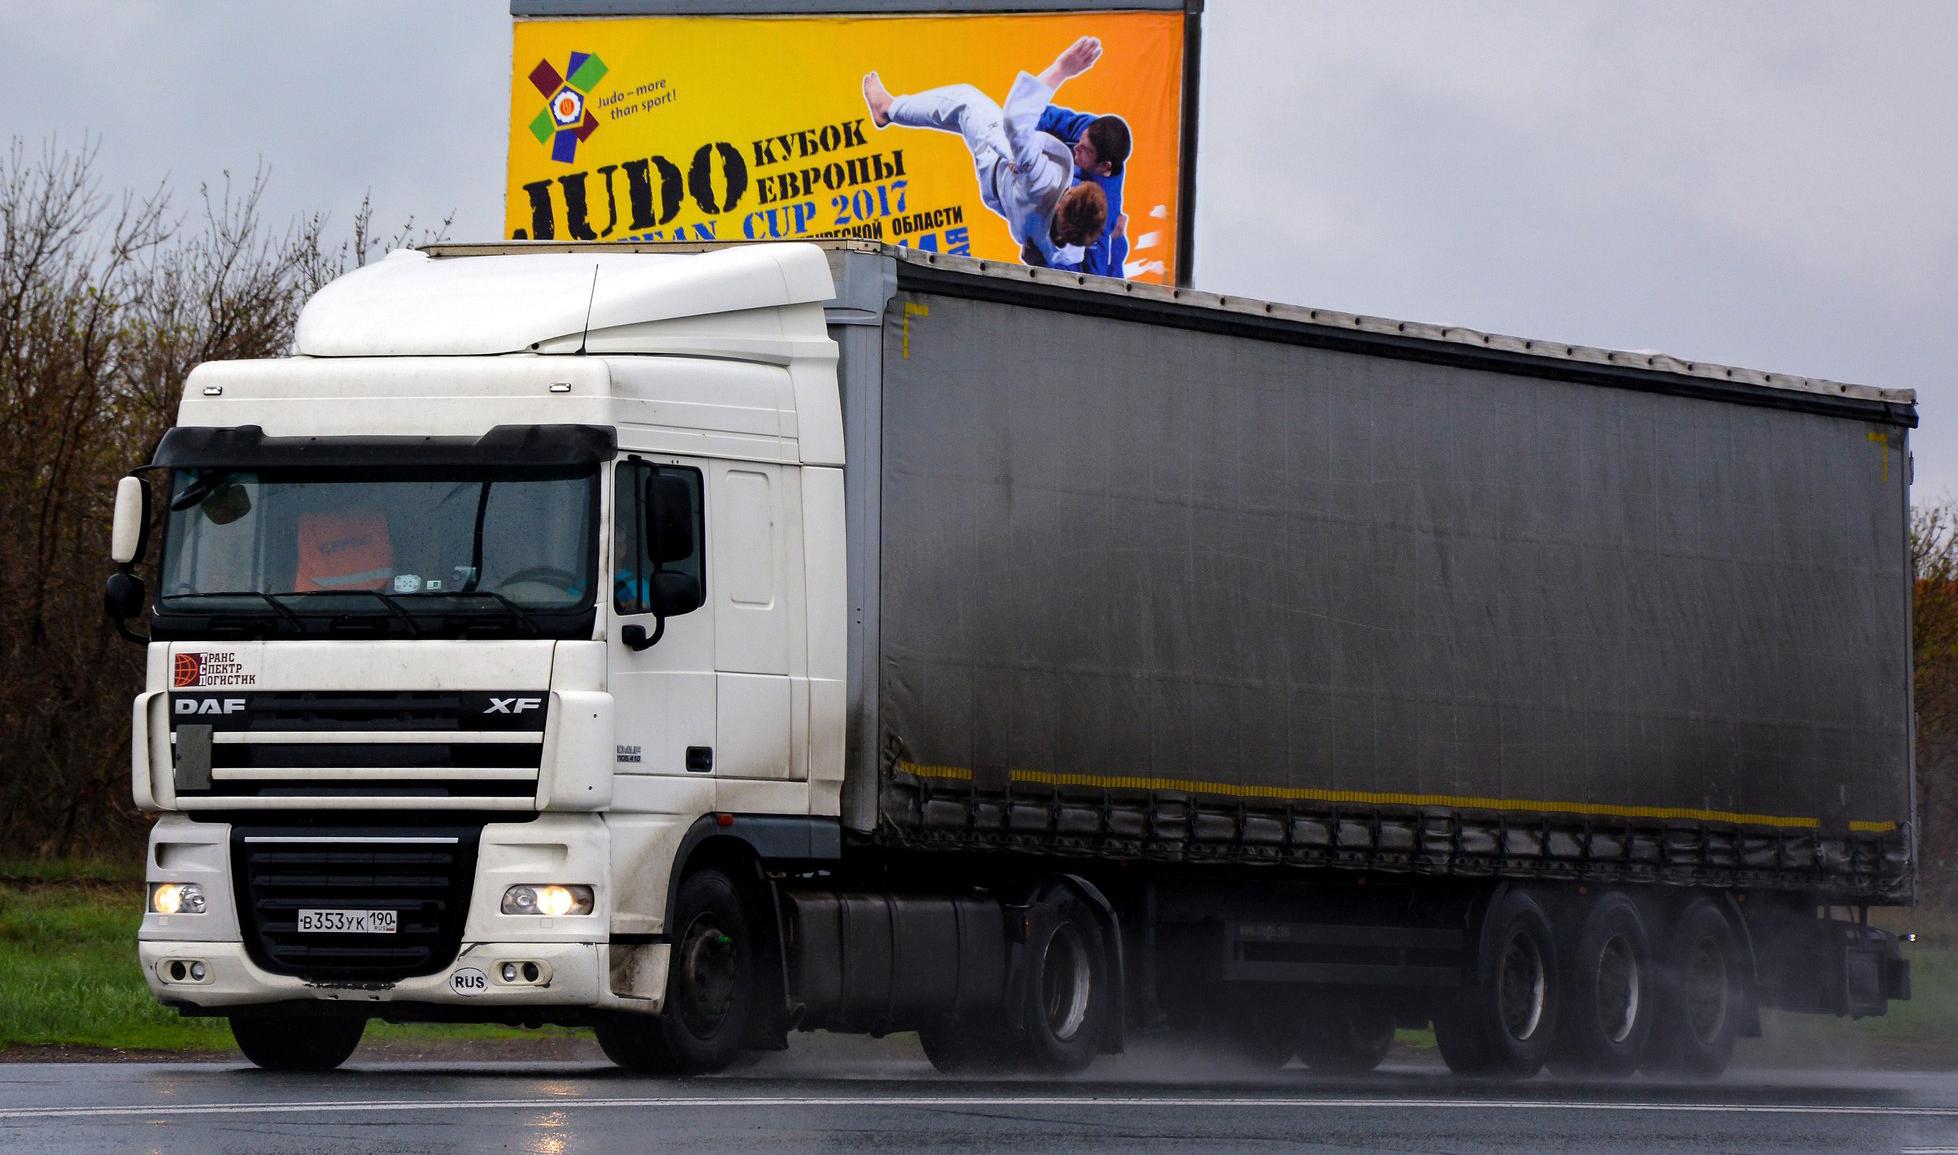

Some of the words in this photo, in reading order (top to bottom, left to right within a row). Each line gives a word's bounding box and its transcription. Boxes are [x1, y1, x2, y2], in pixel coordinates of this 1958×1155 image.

[598, 90, 625, 109] Judo
[636, 79, 667, 96] more
[611, 104, 639, 120] than
[641, 89, 677, 113] sport!
[753, 118, 868, 167] КУБОК
[512, 141, 748, 240] JUDO
[756, 149, 907, 205] ЕВРОПЫ
[743, 201, 816, 239] CUP
[831, 180, 908, 225] 2017
[892, 206, 963, 236] ОБЛАСТИ
[200, 652, 235, 663] ТРАНС
[200, 664, 242, 675] СПЕКТР
[175, 699, 246, 714] DAF
[483, 698, 542, 714] XF
[369, 912, 393, 925] 190
[455, 975, 485, 989] RUS
